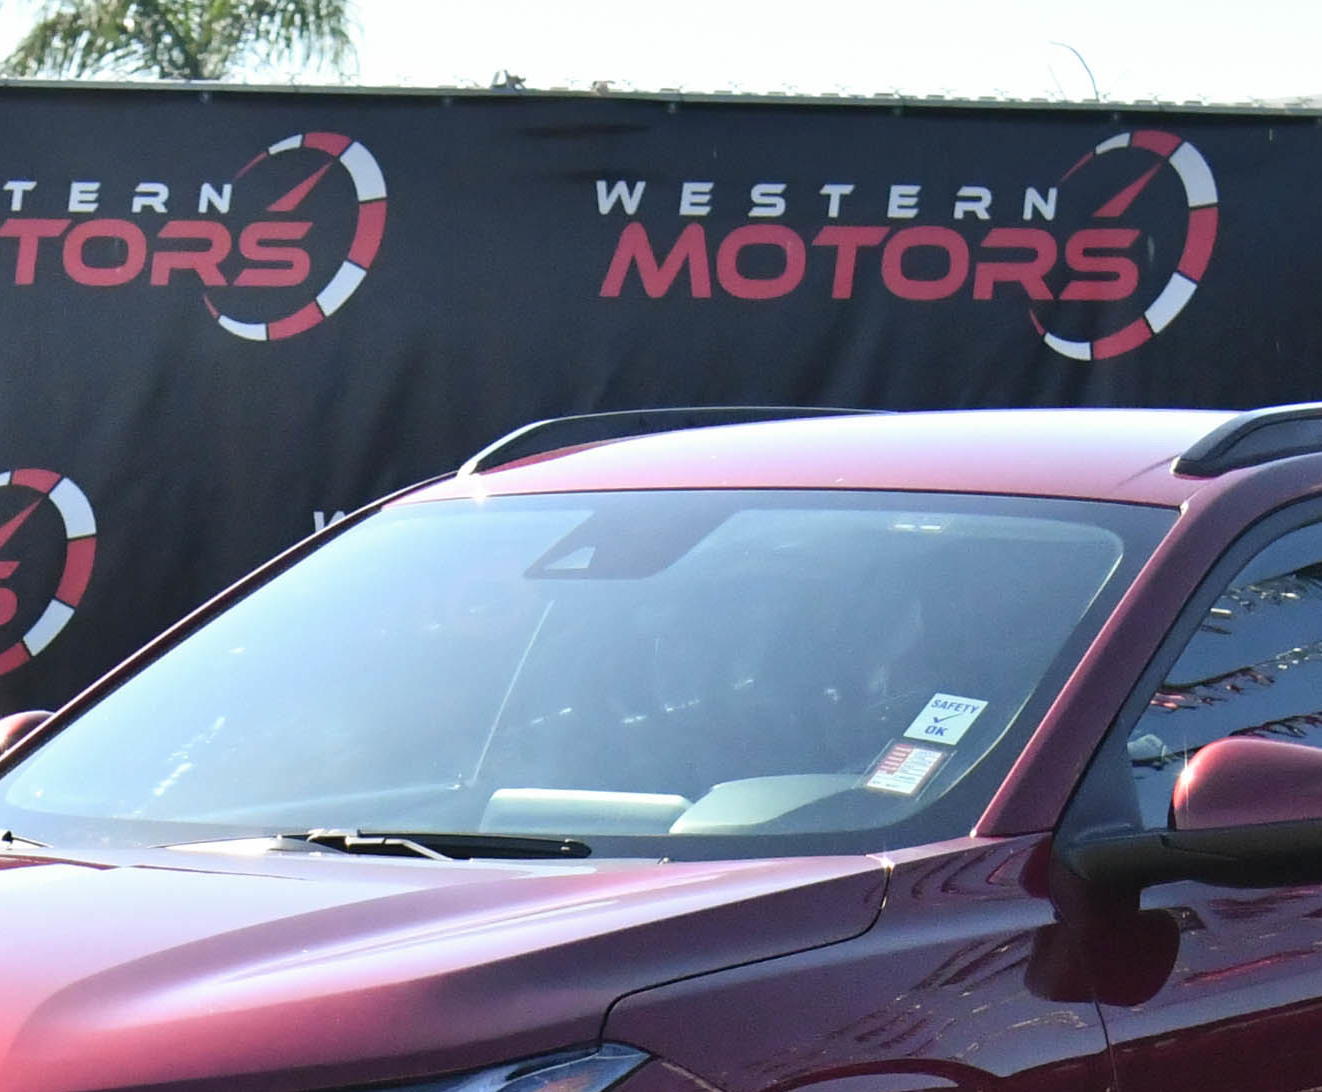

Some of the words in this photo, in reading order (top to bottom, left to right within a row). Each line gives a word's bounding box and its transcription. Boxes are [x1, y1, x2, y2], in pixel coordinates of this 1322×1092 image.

[596, 180, 1058, 221] WESTERN
[599, 222, 1141, 301] MOTORS
[930, 699, 980, 714] SAFETY
[924, 725, 949, 737] OK
